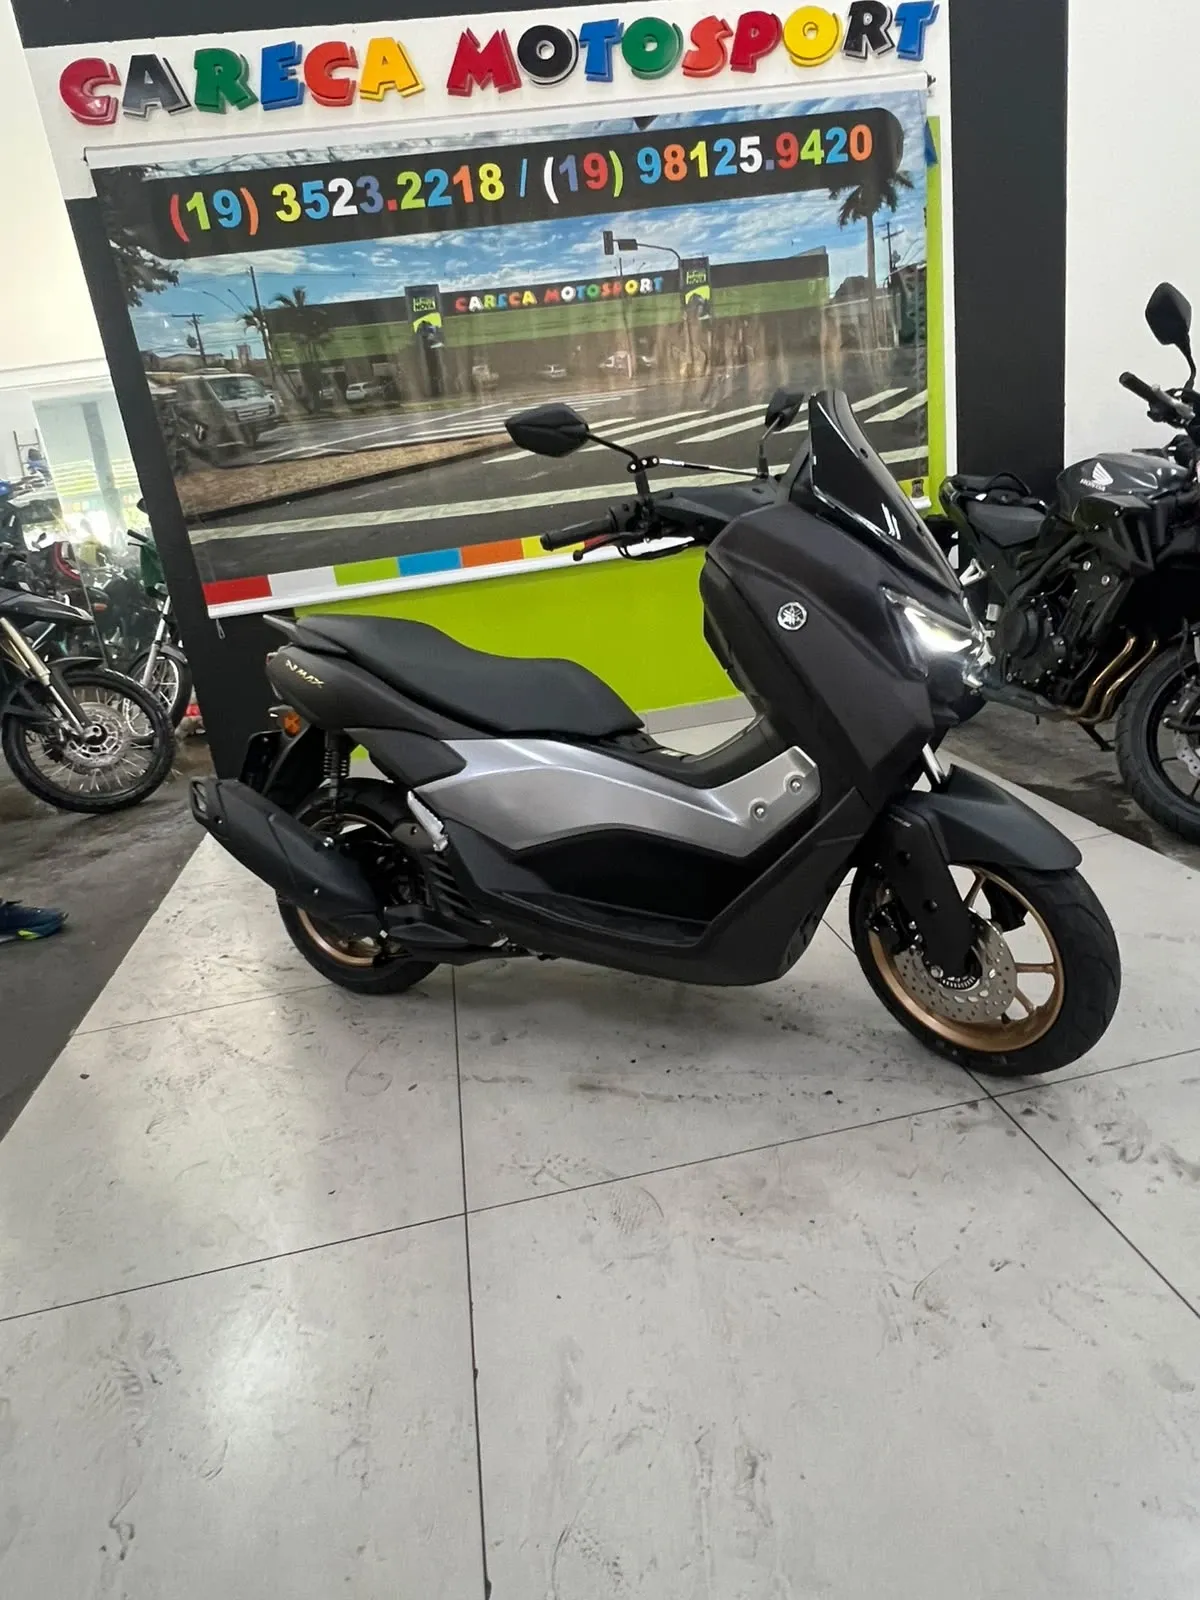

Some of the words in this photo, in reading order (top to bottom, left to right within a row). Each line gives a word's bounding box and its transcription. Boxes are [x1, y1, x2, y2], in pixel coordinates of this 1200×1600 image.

[59, 37, 425, 126] CARECA
[446, 0, 940, 97] MOTOSPORT
[170, 187, 260, 243] (19)
[271, 162, 505, 223] 3523.2218
[543, 150, 625, 205] (19)
[636, 123, 874, 185] 98125.9420
[455, 290, 538, 313] CARECA
[543, 276, 664, 304] MOTOSPORT
[1080, 478, 1106, 492] HONDA
